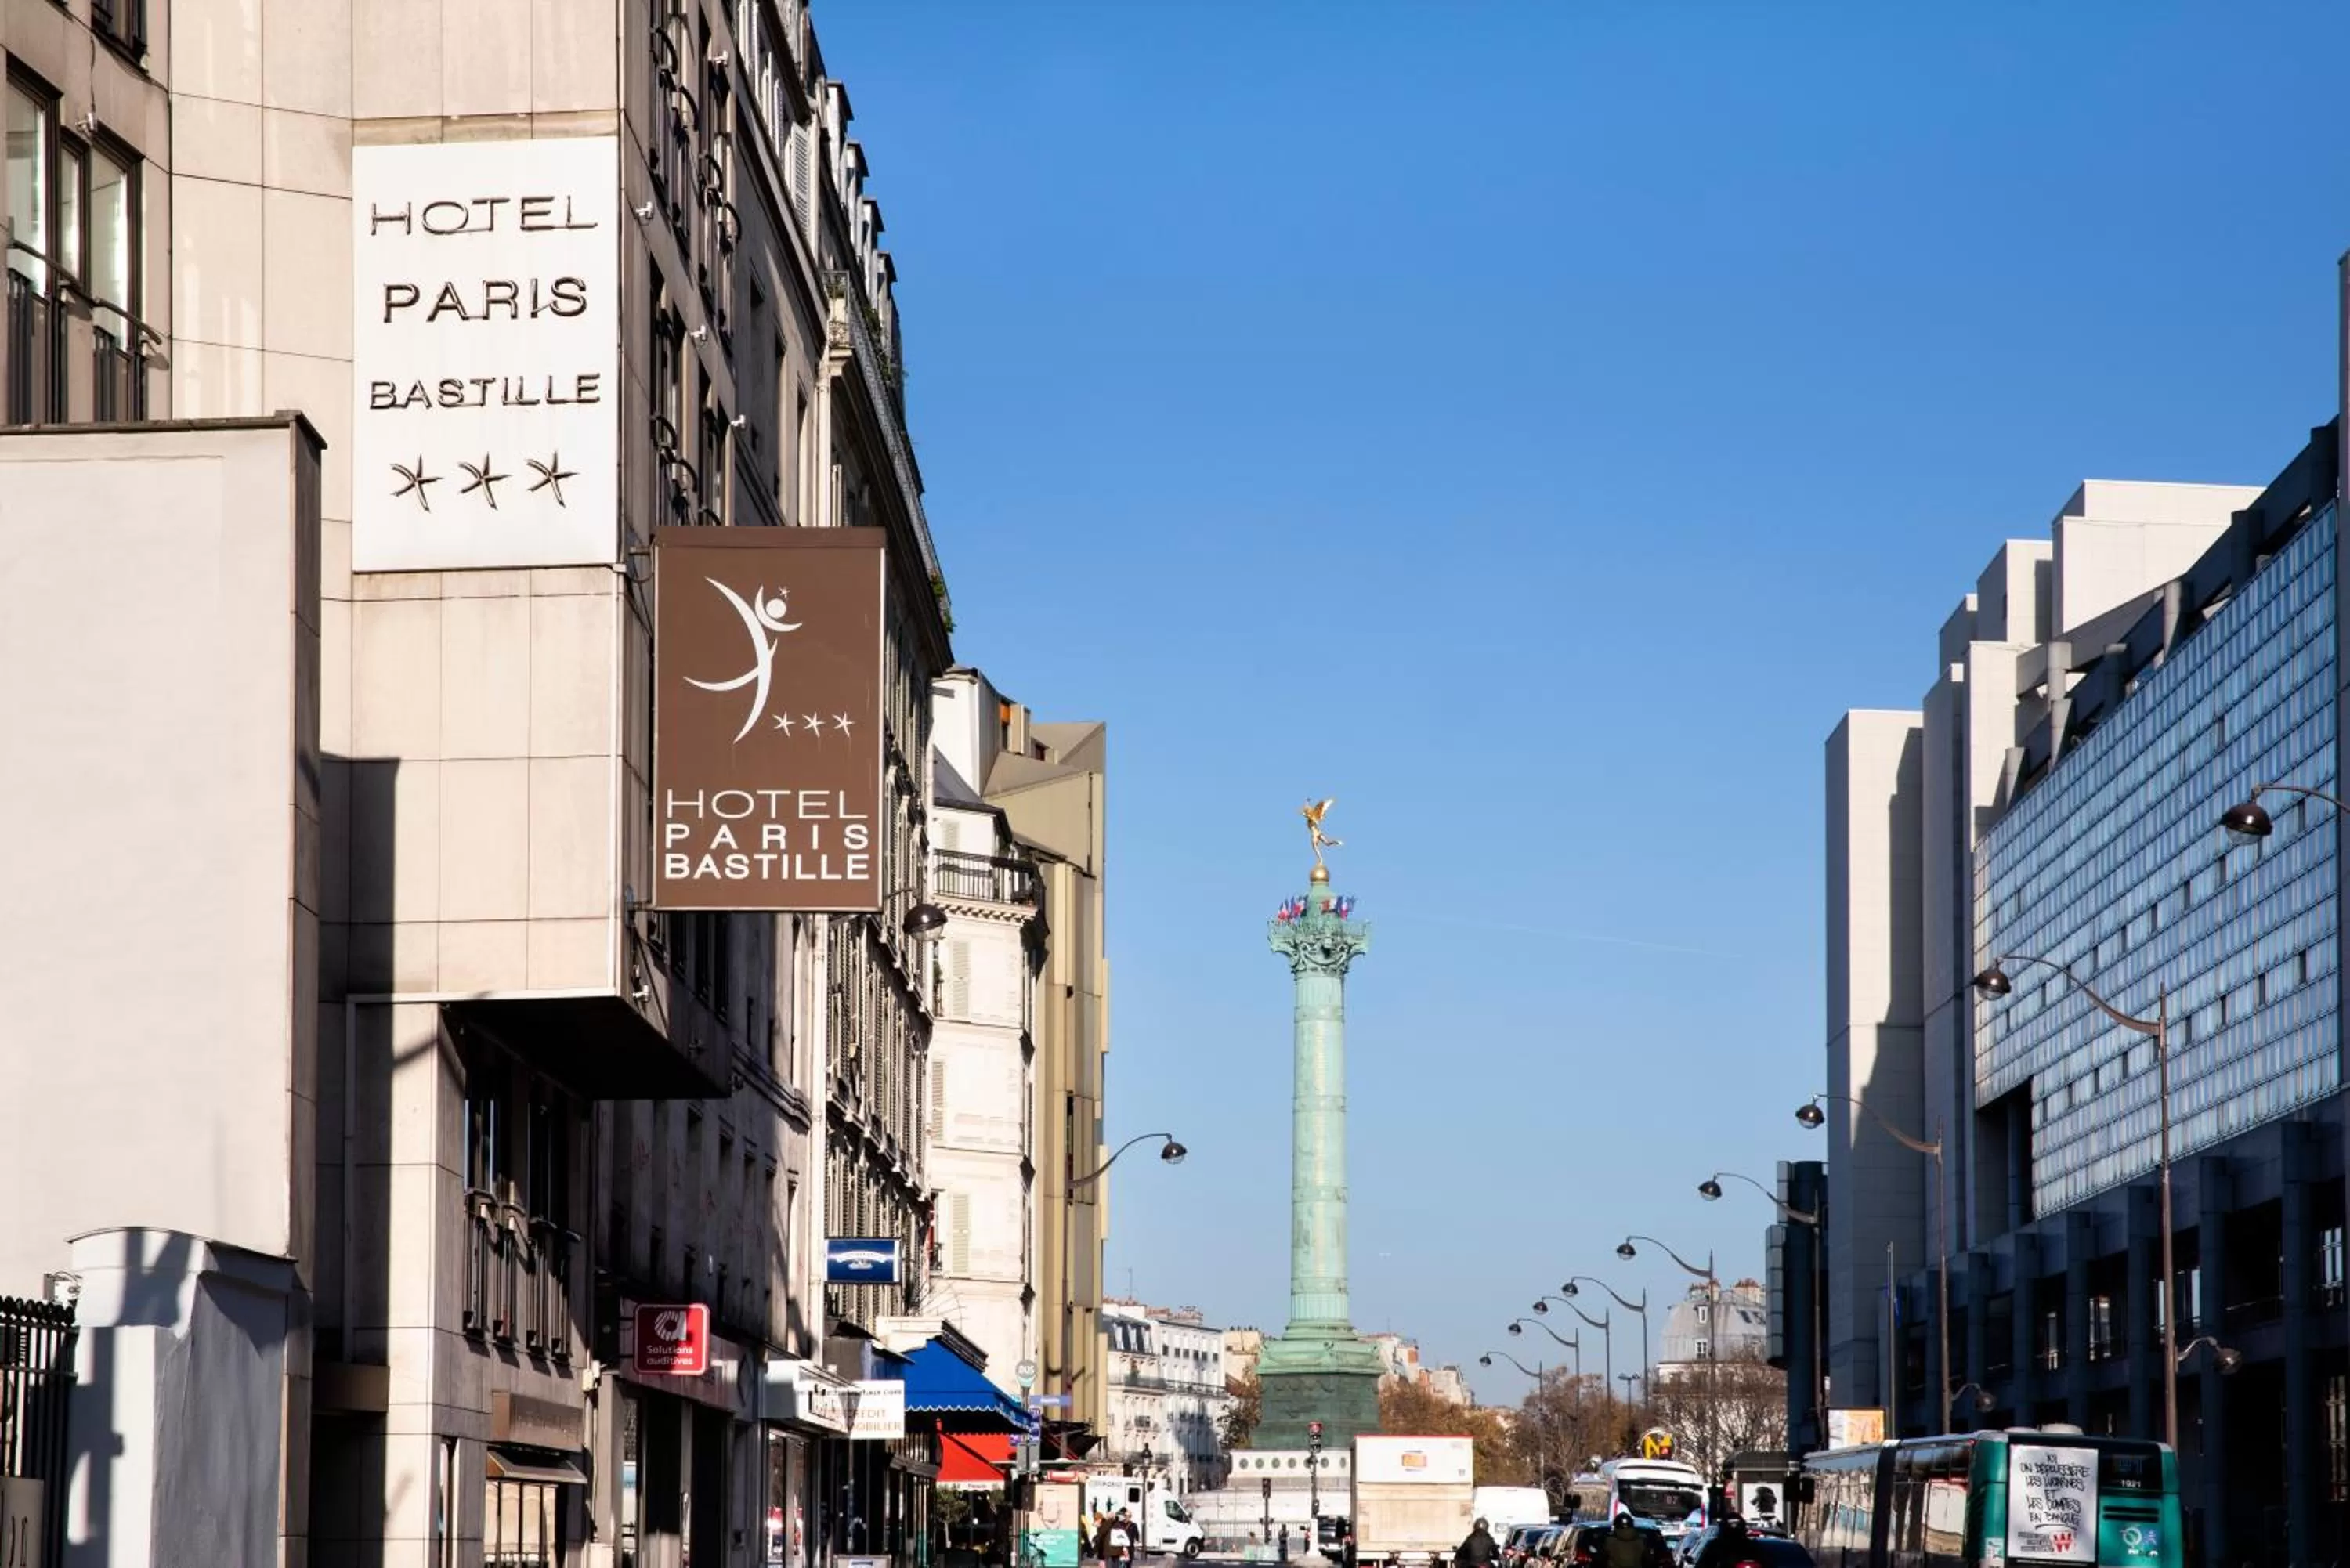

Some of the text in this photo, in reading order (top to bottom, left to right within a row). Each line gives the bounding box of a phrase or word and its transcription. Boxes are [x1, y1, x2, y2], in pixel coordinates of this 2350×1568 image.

[371, 196, 598, 235] HOTEL
[383, 277, 587, 323] PARIS
[370, 373, 600, 410] BASTILLE
[667, 789, 868, 818] HOTEL
[666, 824, 869, 850] PARIS
[665, 853, 870, 880] BASTILLE
[646, 1345, 693, 1354] Solutions
[646, 1356, 693, 1365] auditives
